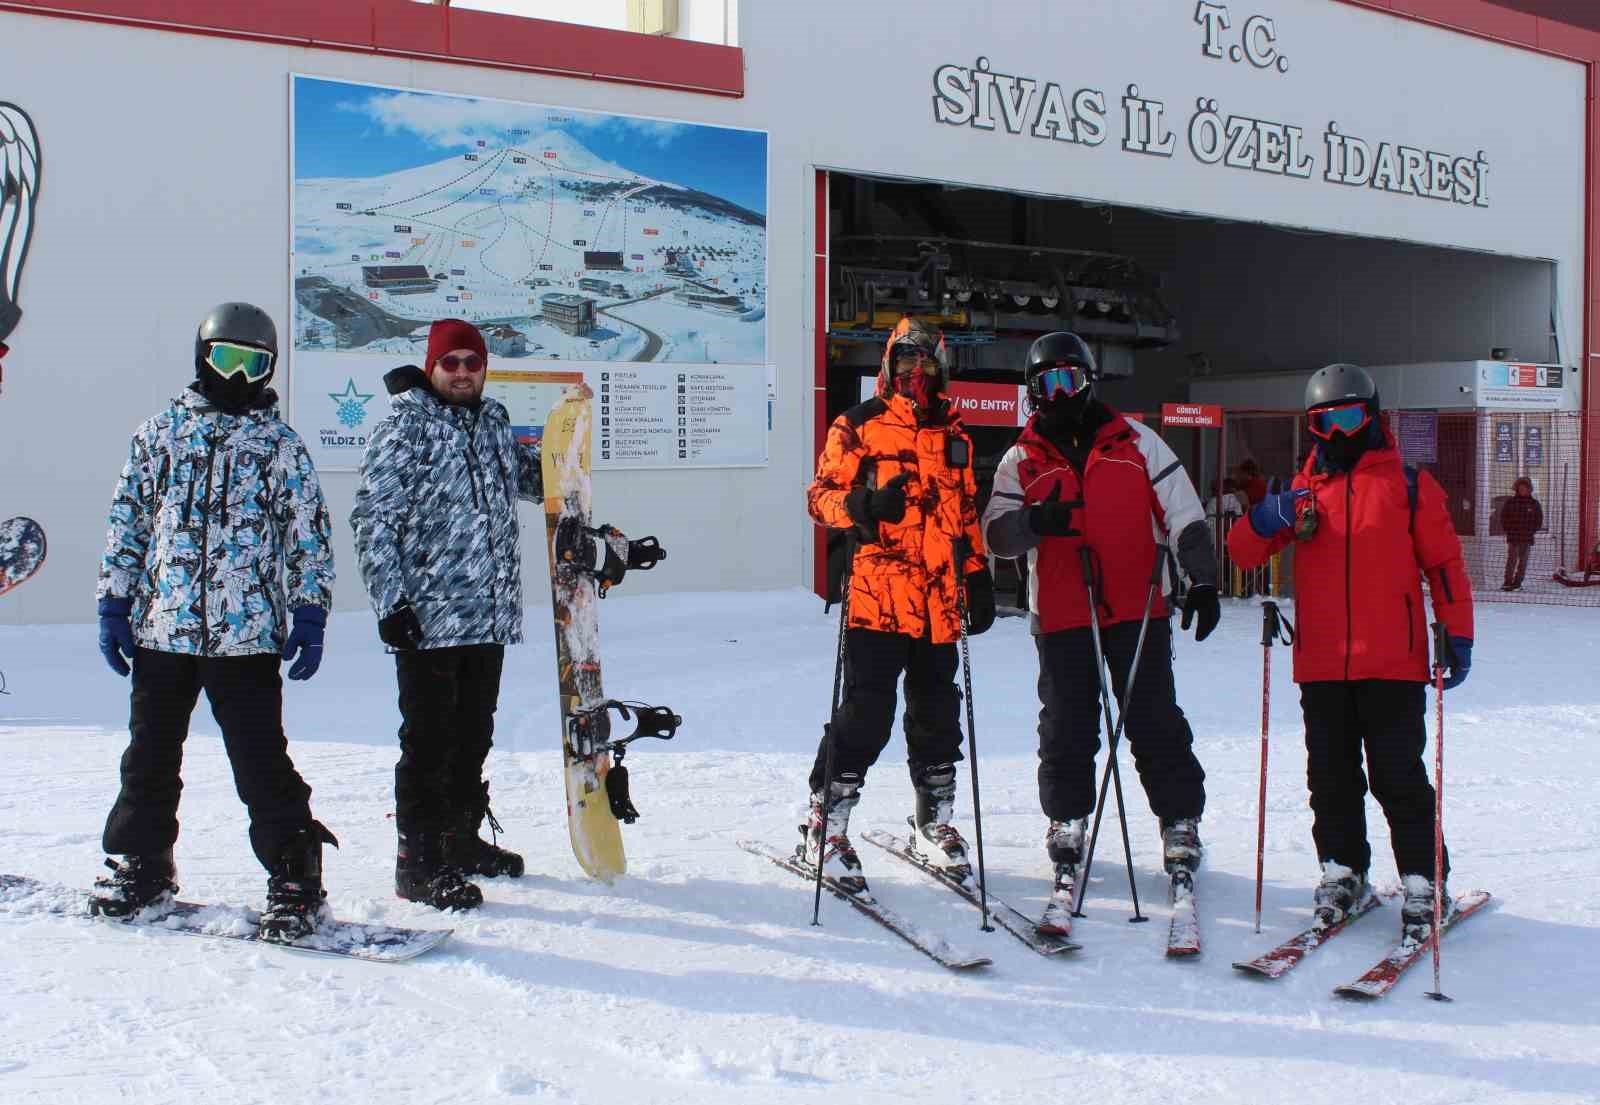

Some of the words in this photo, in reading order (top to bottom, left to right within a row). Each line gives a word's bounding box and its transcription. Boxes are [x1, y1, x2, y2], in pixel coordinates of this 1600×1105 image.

[1194, 0, 1288, 73] T.C.
[933, 56, 1107, 147] SİVAS
[1122, 83, 1176, 157] İL
[1188, 97, 1314, 179] ÖZEL
[1325, 120, 1489, 208] İDARESİ
[962, 399, 979, 410] NO
[981, 399, 1016, 411] ENTRY
[320, 436, 355, 445] YILDIZ
